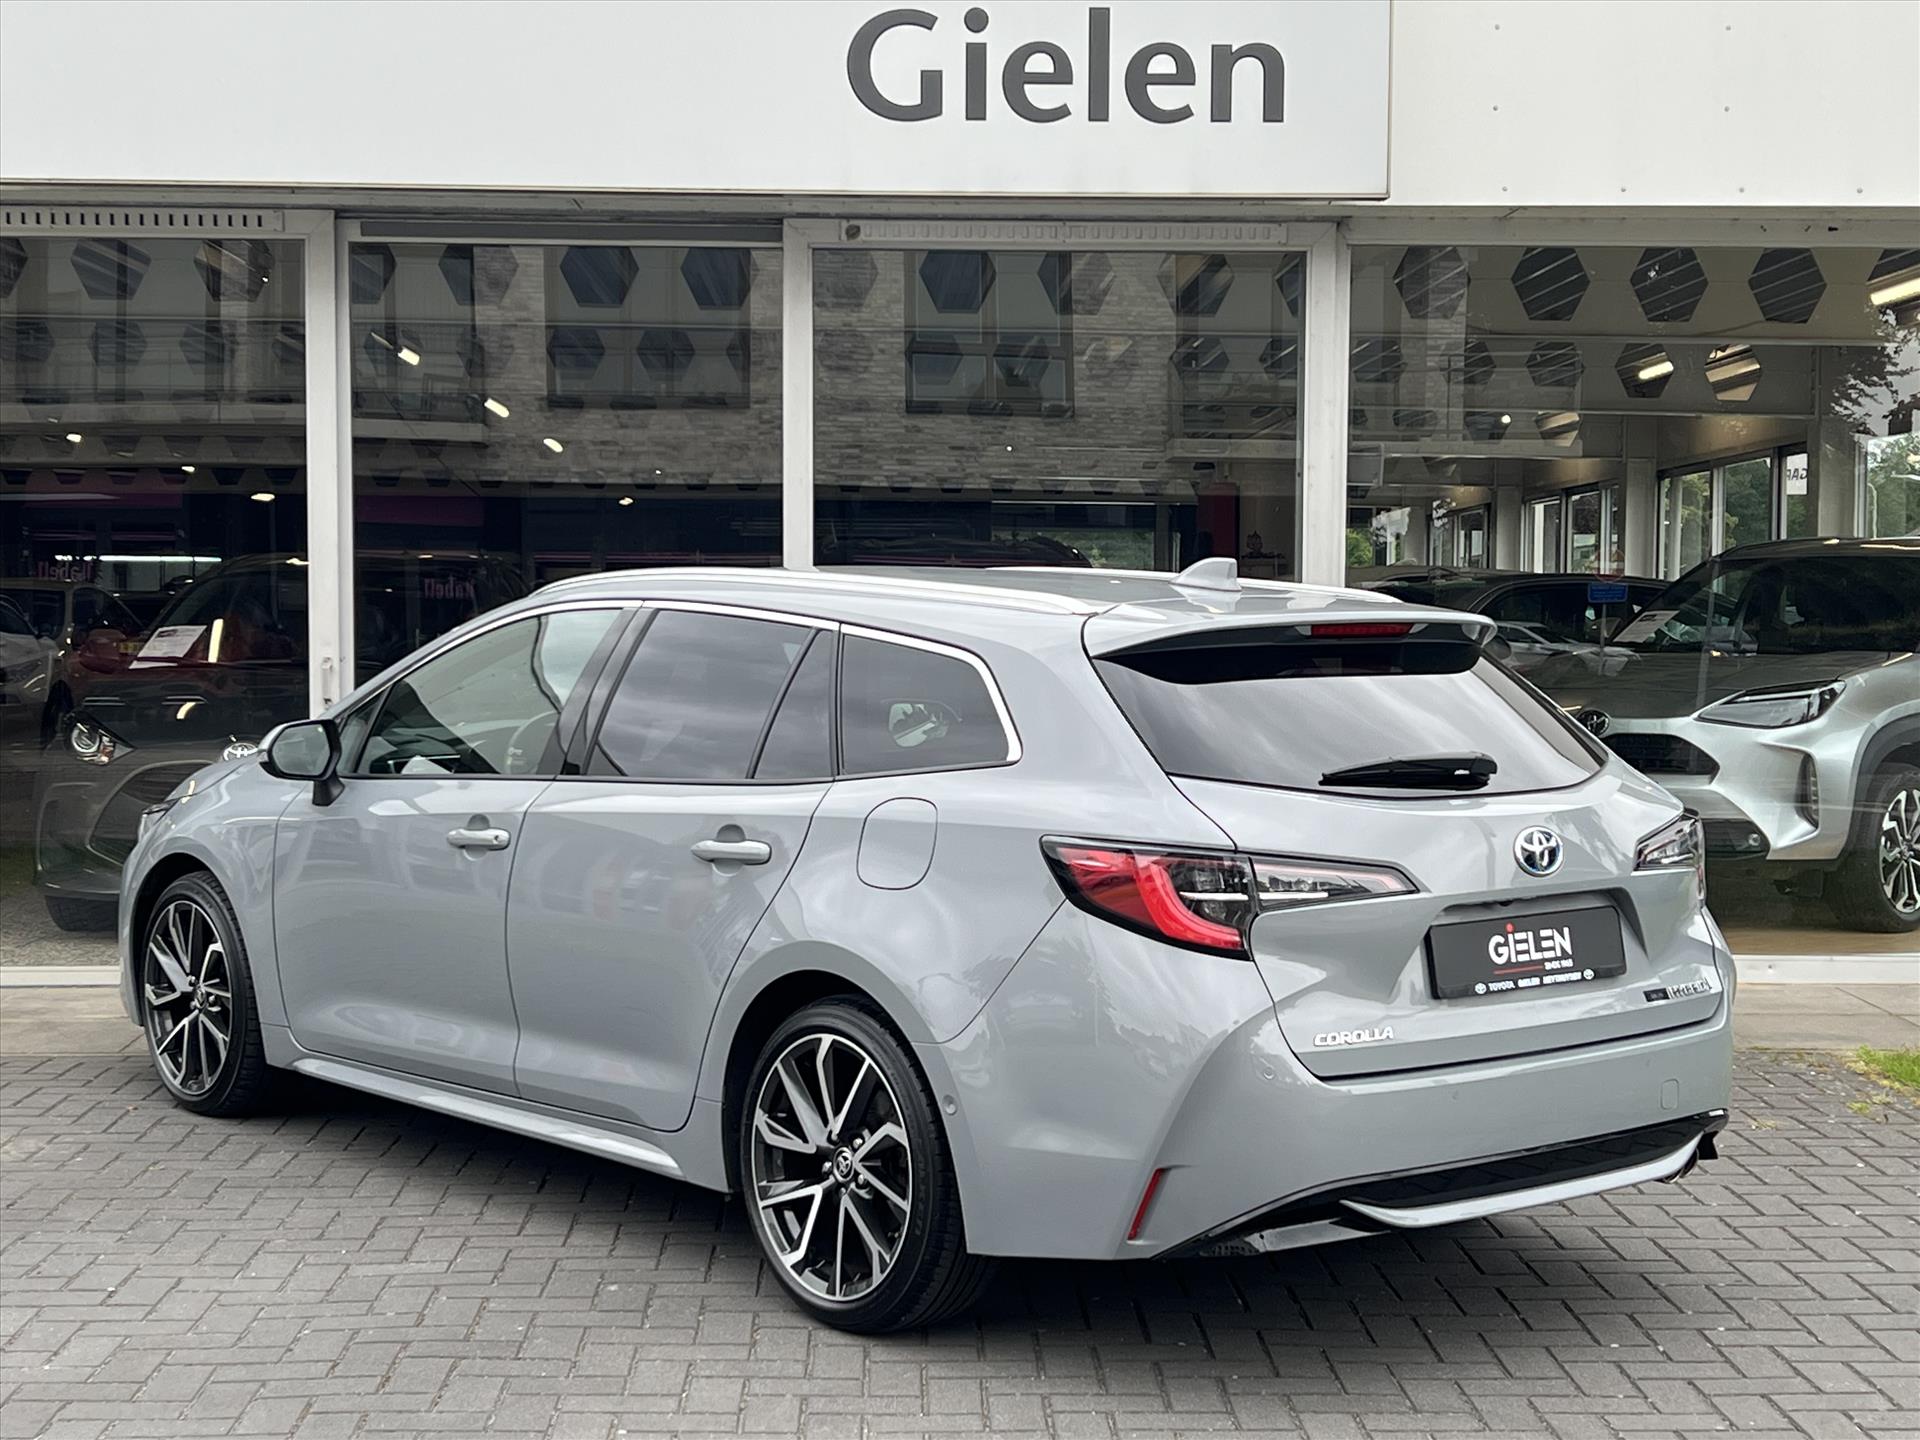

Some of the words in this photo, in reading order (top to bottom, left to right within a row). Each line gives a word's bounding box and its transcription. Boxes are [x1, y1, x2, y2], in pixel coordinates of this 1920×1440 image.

[847, 7, 1285, 124] Gielen
[1488, 980, 1516, 992] TOYOTA
[1313, 1026, 1394, 1047] COROLLA
